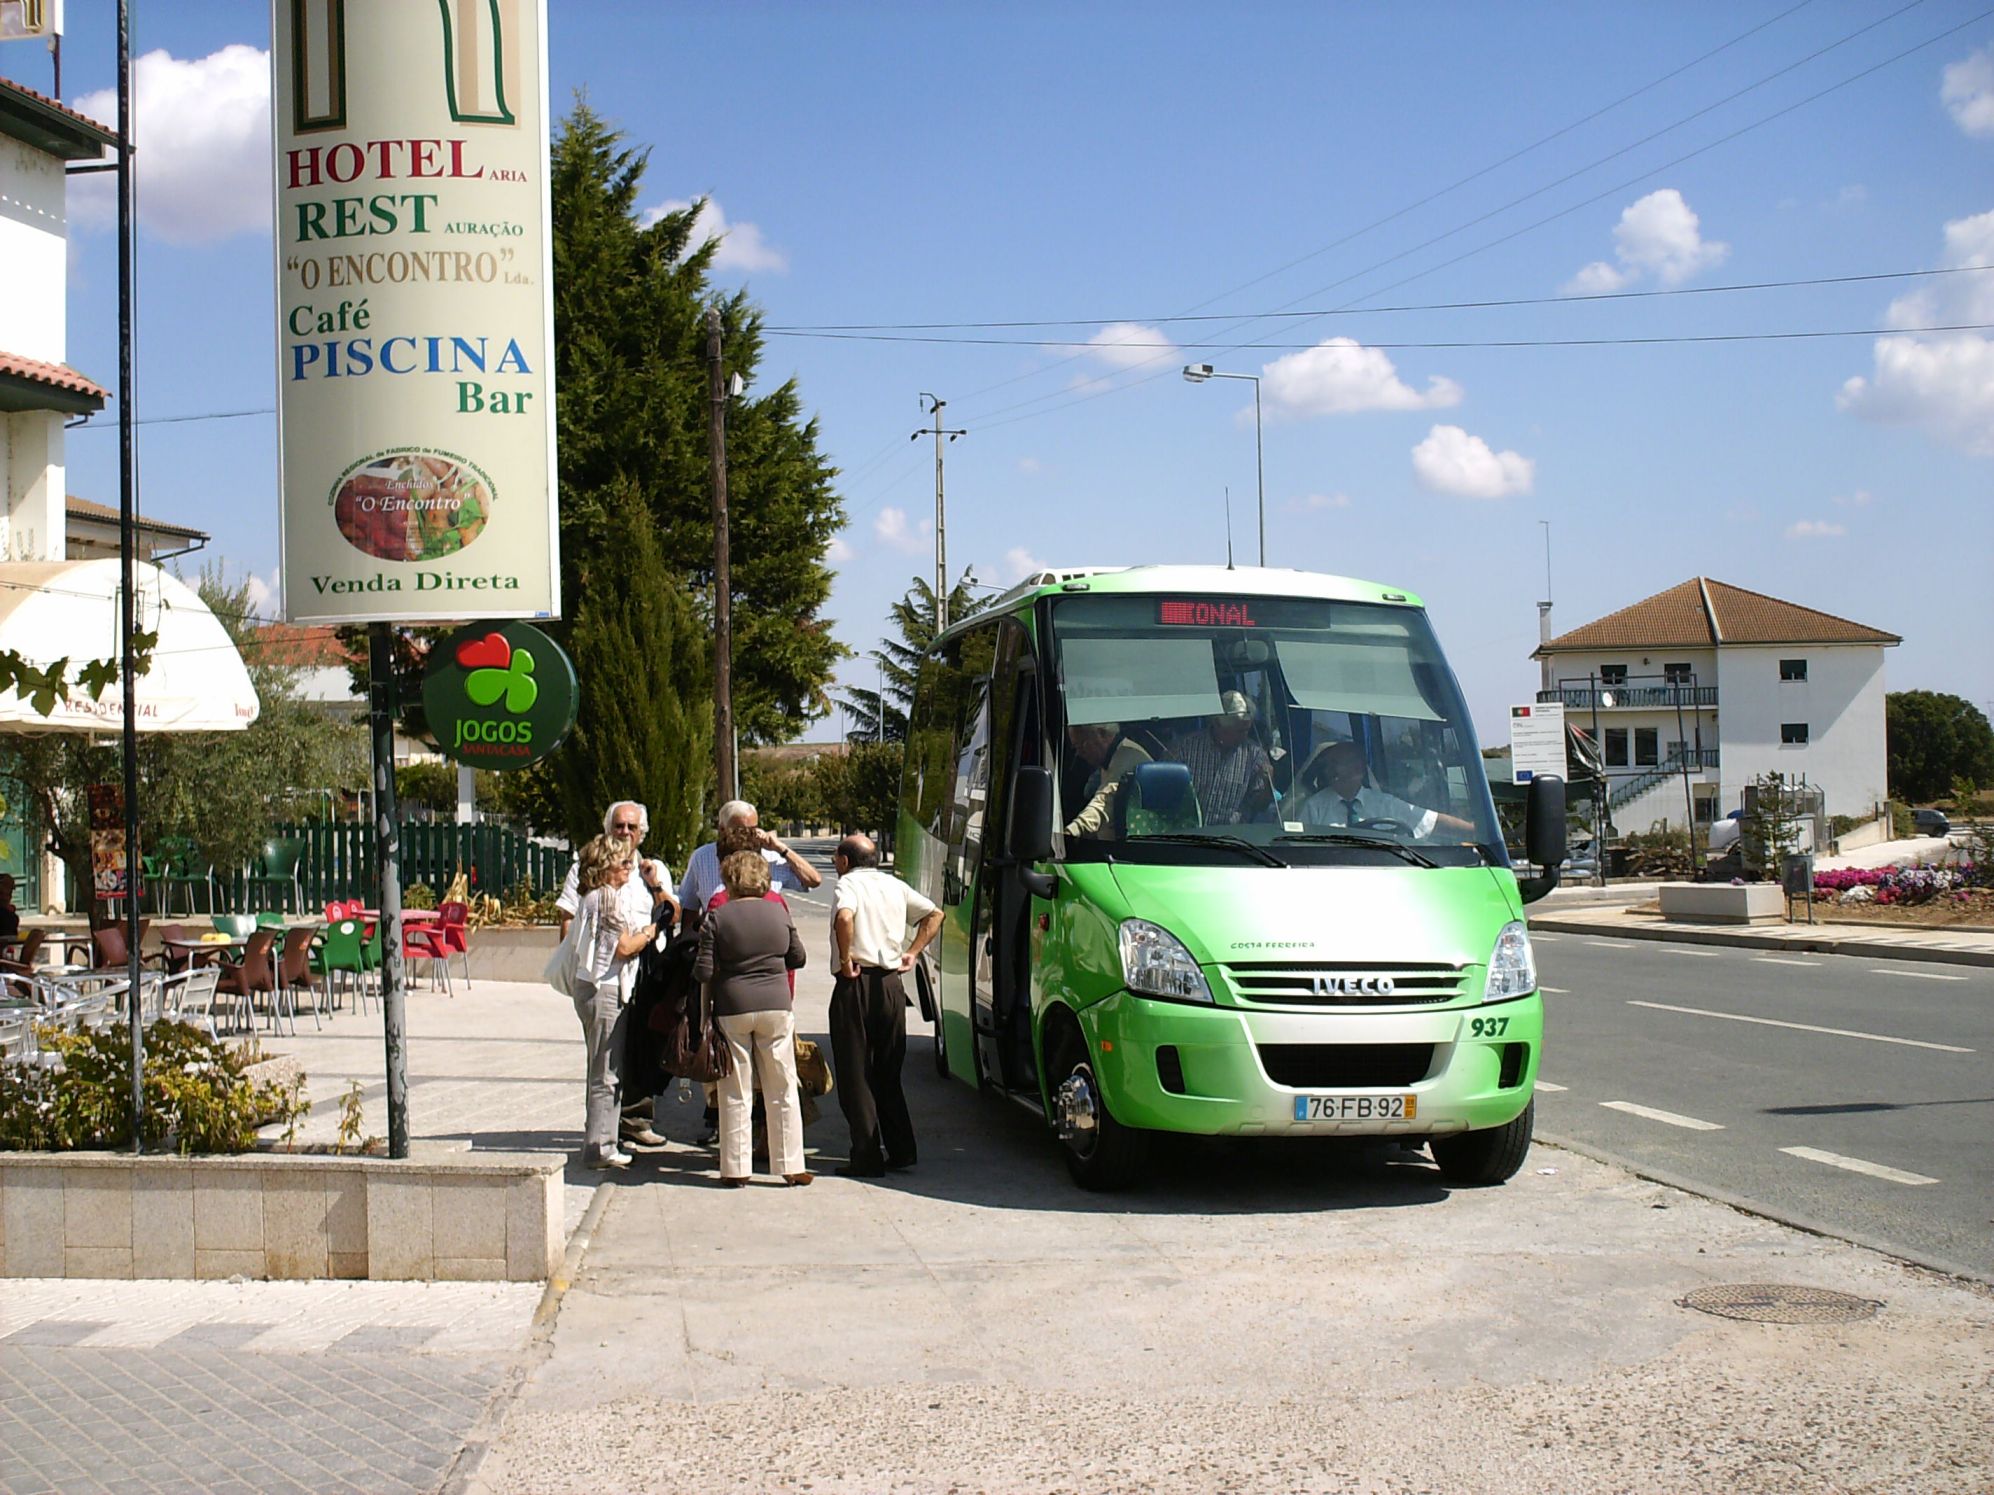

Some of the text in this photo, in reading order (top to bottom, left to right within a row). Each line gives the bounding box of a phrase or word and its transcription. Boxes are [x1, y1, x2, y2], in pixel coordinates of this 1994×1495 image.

[286, 139, 528, 189] HOTEL ARIA
[295, 194, 524, 242] REST AURAÇÃO
[504, 271, 535, 285] Lda.
[289, 298, 370, 336] Café
[291, 336, 533, 381] PISCINA
[456, 381, 533, 414] Bar
[311, 571, 520, 594] Venda Direta
[454, 719, 533, 748] JOGOS
[1312, 976, 1395, 995] IVECO
[1471, 1017, 1509, 1038] 937
